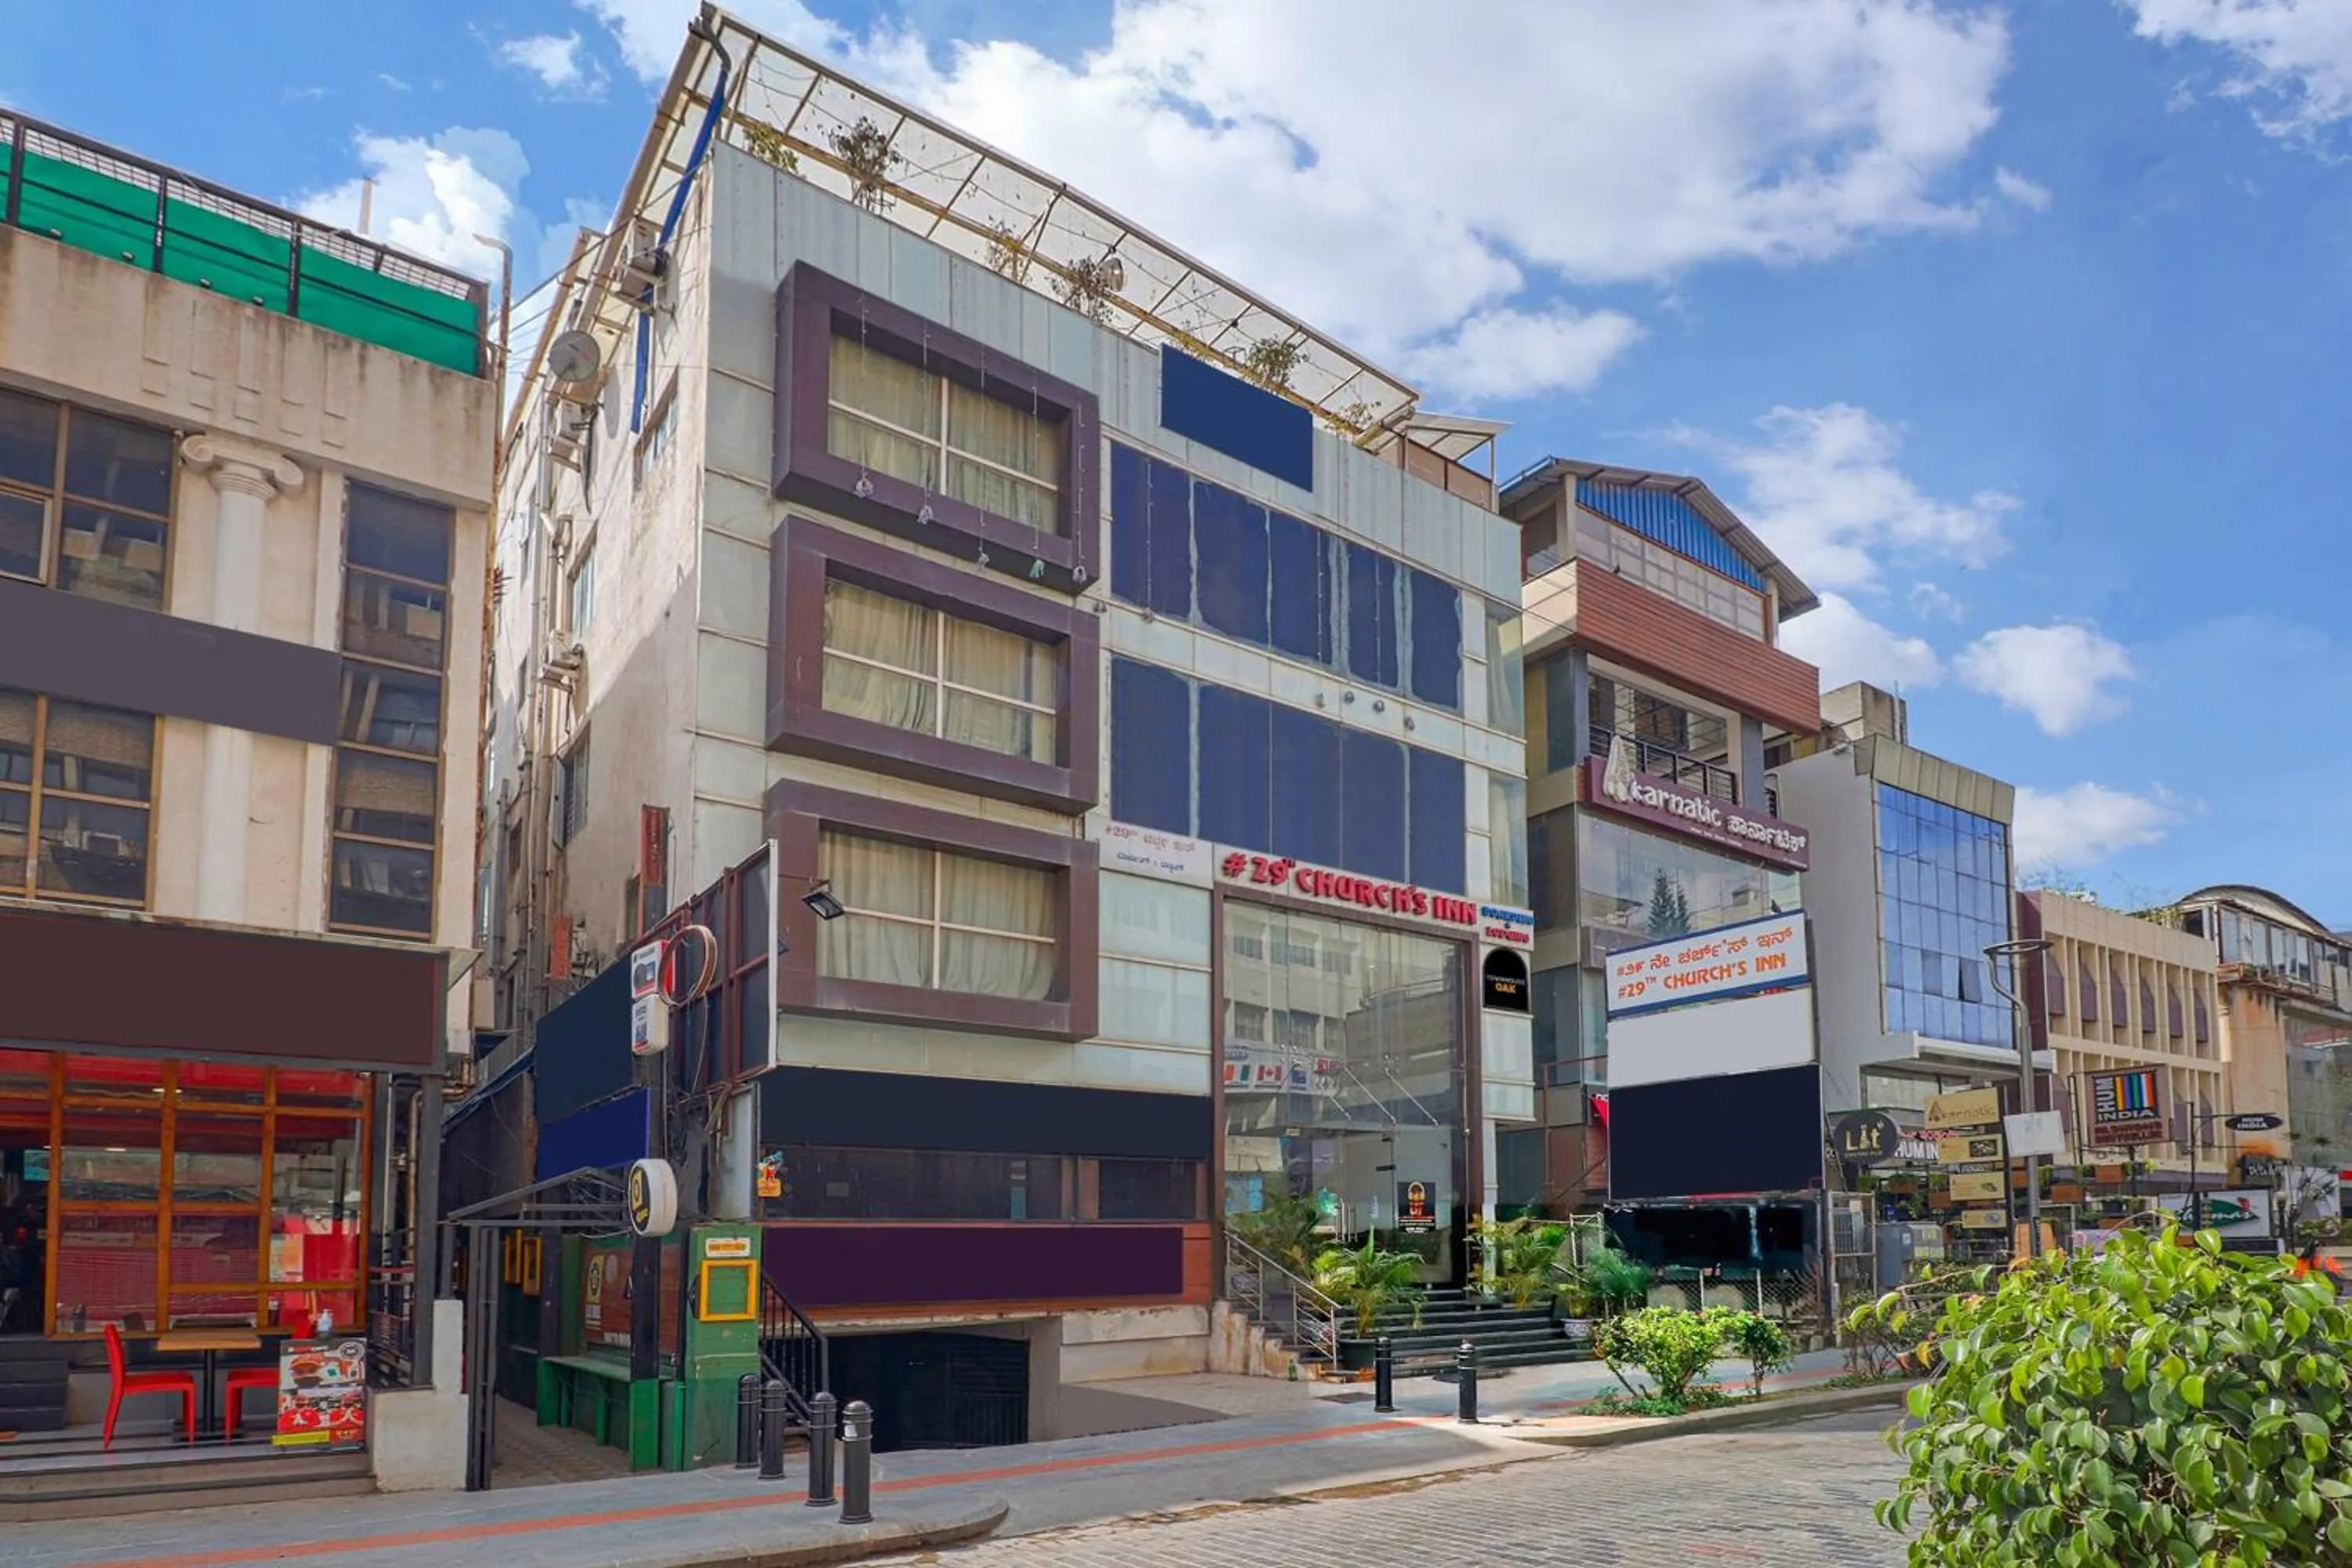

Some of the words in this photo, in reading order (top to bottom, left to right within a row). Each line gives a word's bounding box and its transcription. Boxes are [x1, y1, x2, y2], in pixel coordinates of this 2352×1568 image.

[1629, 780, 1722, 826] karnatic
[1296, 866, 1428, 915] CHURCH'S
[1431, 895, 1477, 926] INN
[1495, 982, 1516, 994] OAK
[1663, 960, 1748, 989] CHURCH'S
[1755, 953, 1787, 973] INN
[2096, 1076, 2115, 1112] HUM
[2097, 1109, 2155, 1122] INDIA
